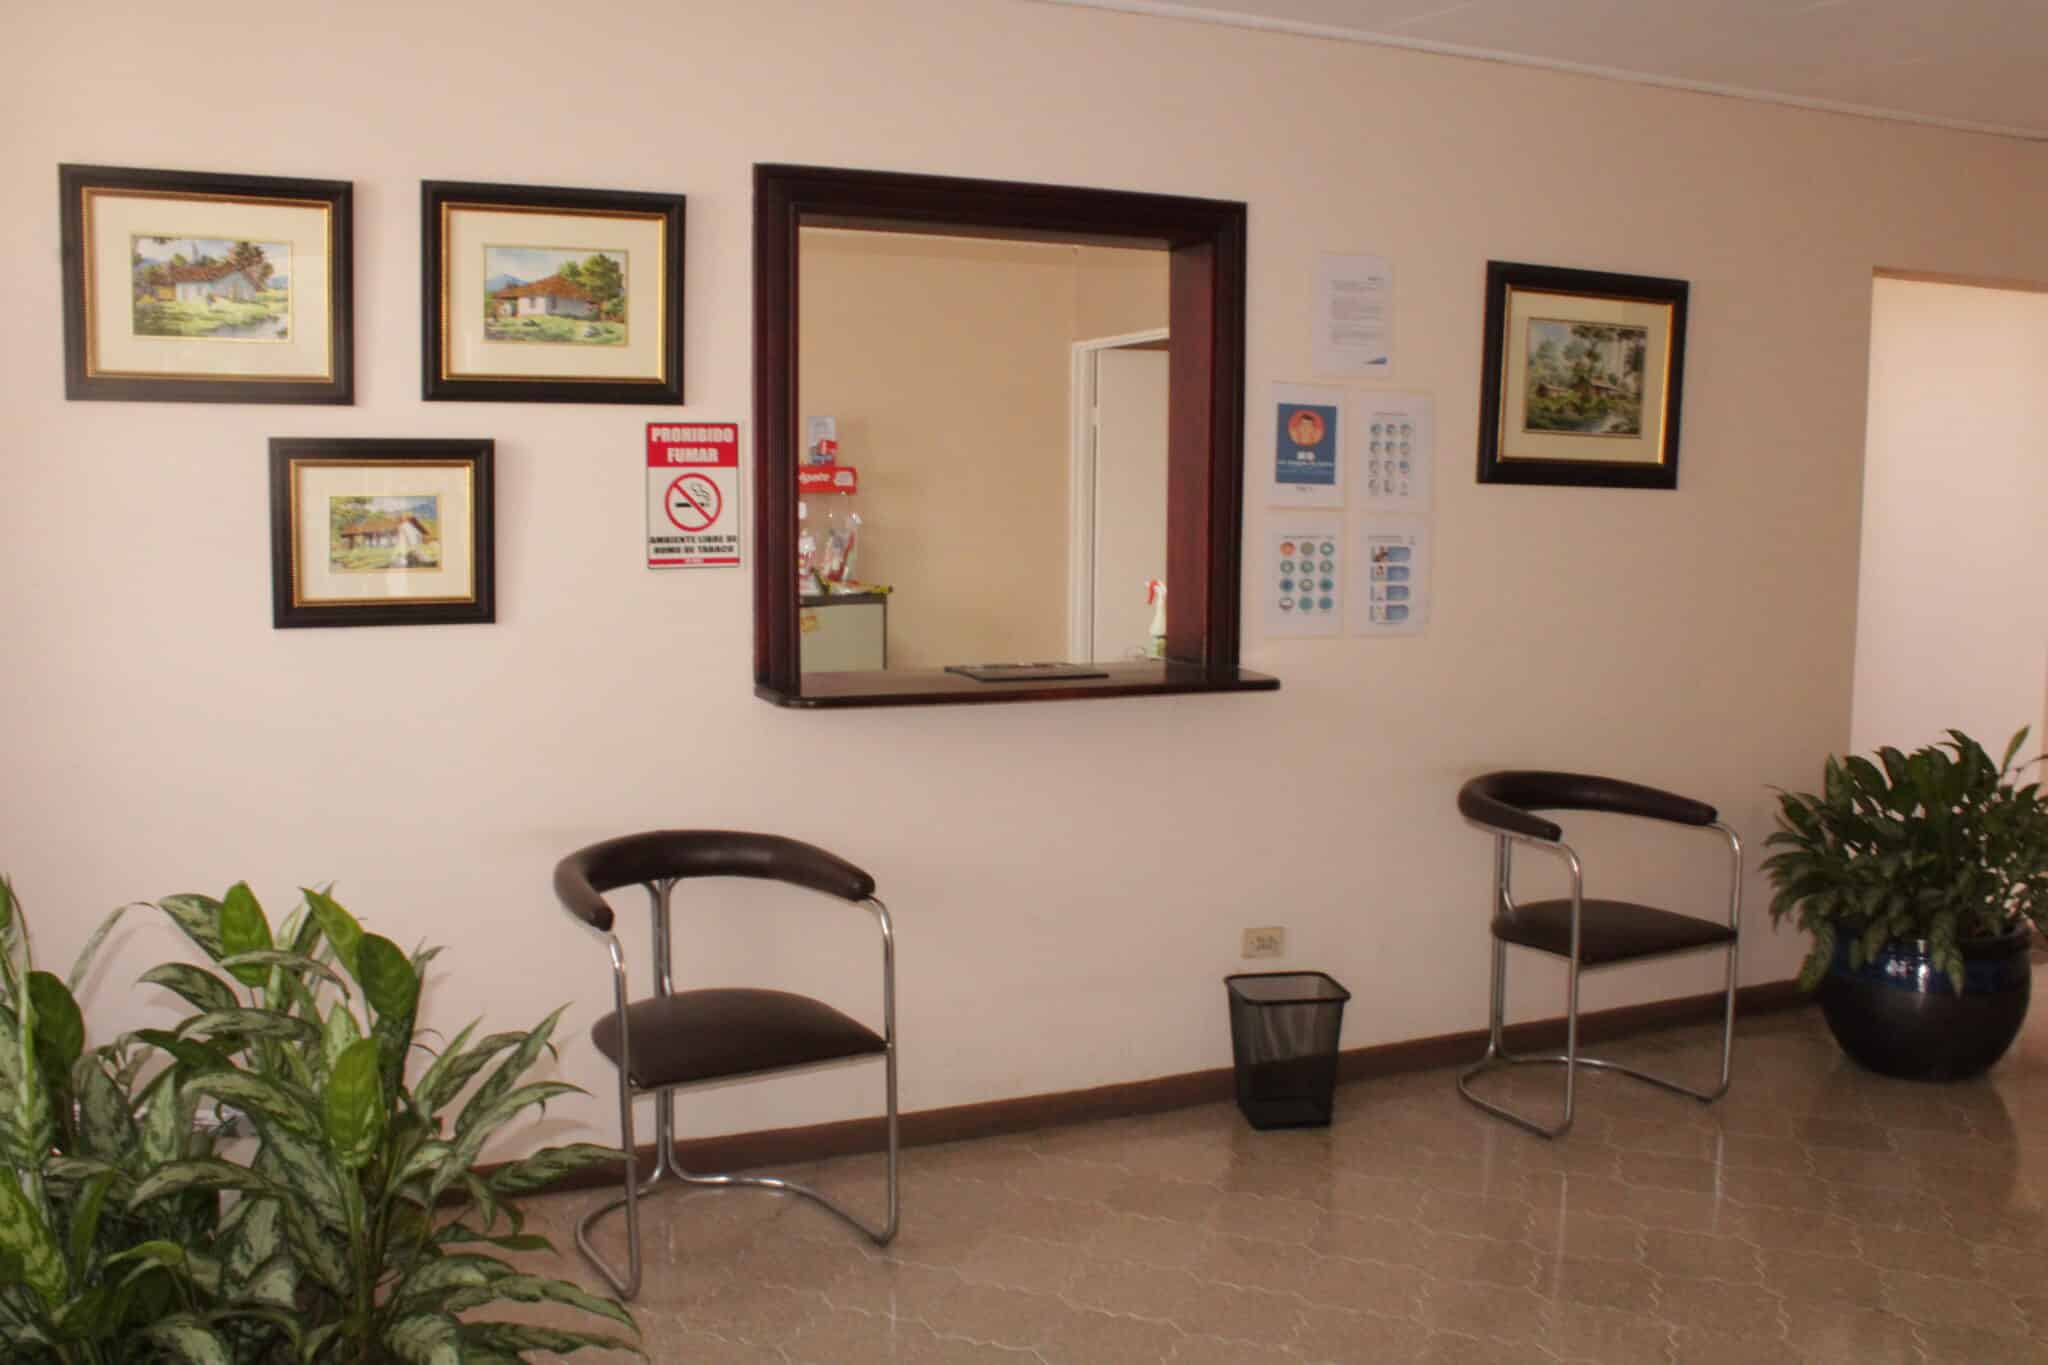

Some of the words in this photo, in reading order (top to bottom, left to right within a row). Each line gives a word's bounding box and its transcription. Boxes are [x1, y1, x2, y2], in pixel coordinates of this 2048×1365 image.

[651, 427, 734, 443] PROHIBIDO
[666, 447, 719, 464] FUMAR
[649, 535, 696, 544] AMBIENTE
[698, 535, 723, 543] LIBRE
[727, 534, 737, 543] DE
[653, 546, 681, 554] HUMO
[698, 545, 734, 553] TABACO
